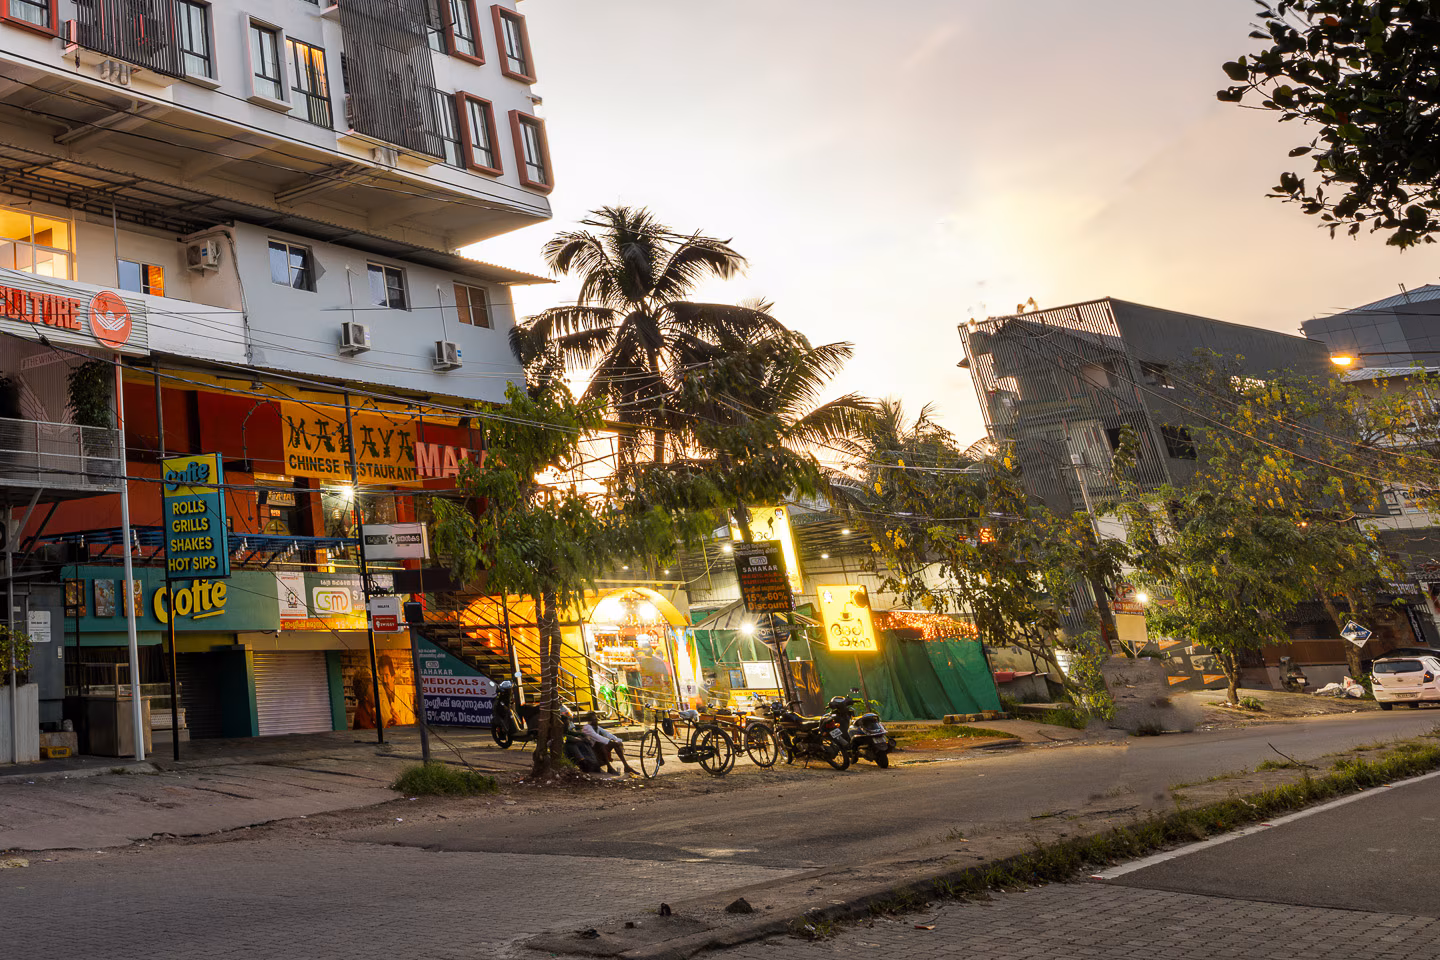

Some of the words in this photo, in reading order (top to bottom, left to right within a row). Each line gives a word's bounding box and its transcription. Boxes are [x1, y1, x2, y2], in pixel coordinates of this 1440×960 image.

[286, 415, 416, 463] MALAYA
[289, 454, 340, 474] CHINESE
[172, 499, 206, 515] ROLLS
[171, 517, 209, 533] GRILLS
[170, 536, 213, 552] SHAKES
[168, 557, 191, 573] HOT
[192, 555, 217, 571] SIPS
[742, 565, 778, 573] SAHAKAR
[745, 592, 788, 601] 15%-60%
[747, 601, 789, 611] Discount
[421, 677, 479, 686] MEDICALS
[422, 687, 487, 695] SURGICALS
[451, 699, 493, 711] മരുന്നുകൾ
[426, 711, 458, 723] 5%-60%
